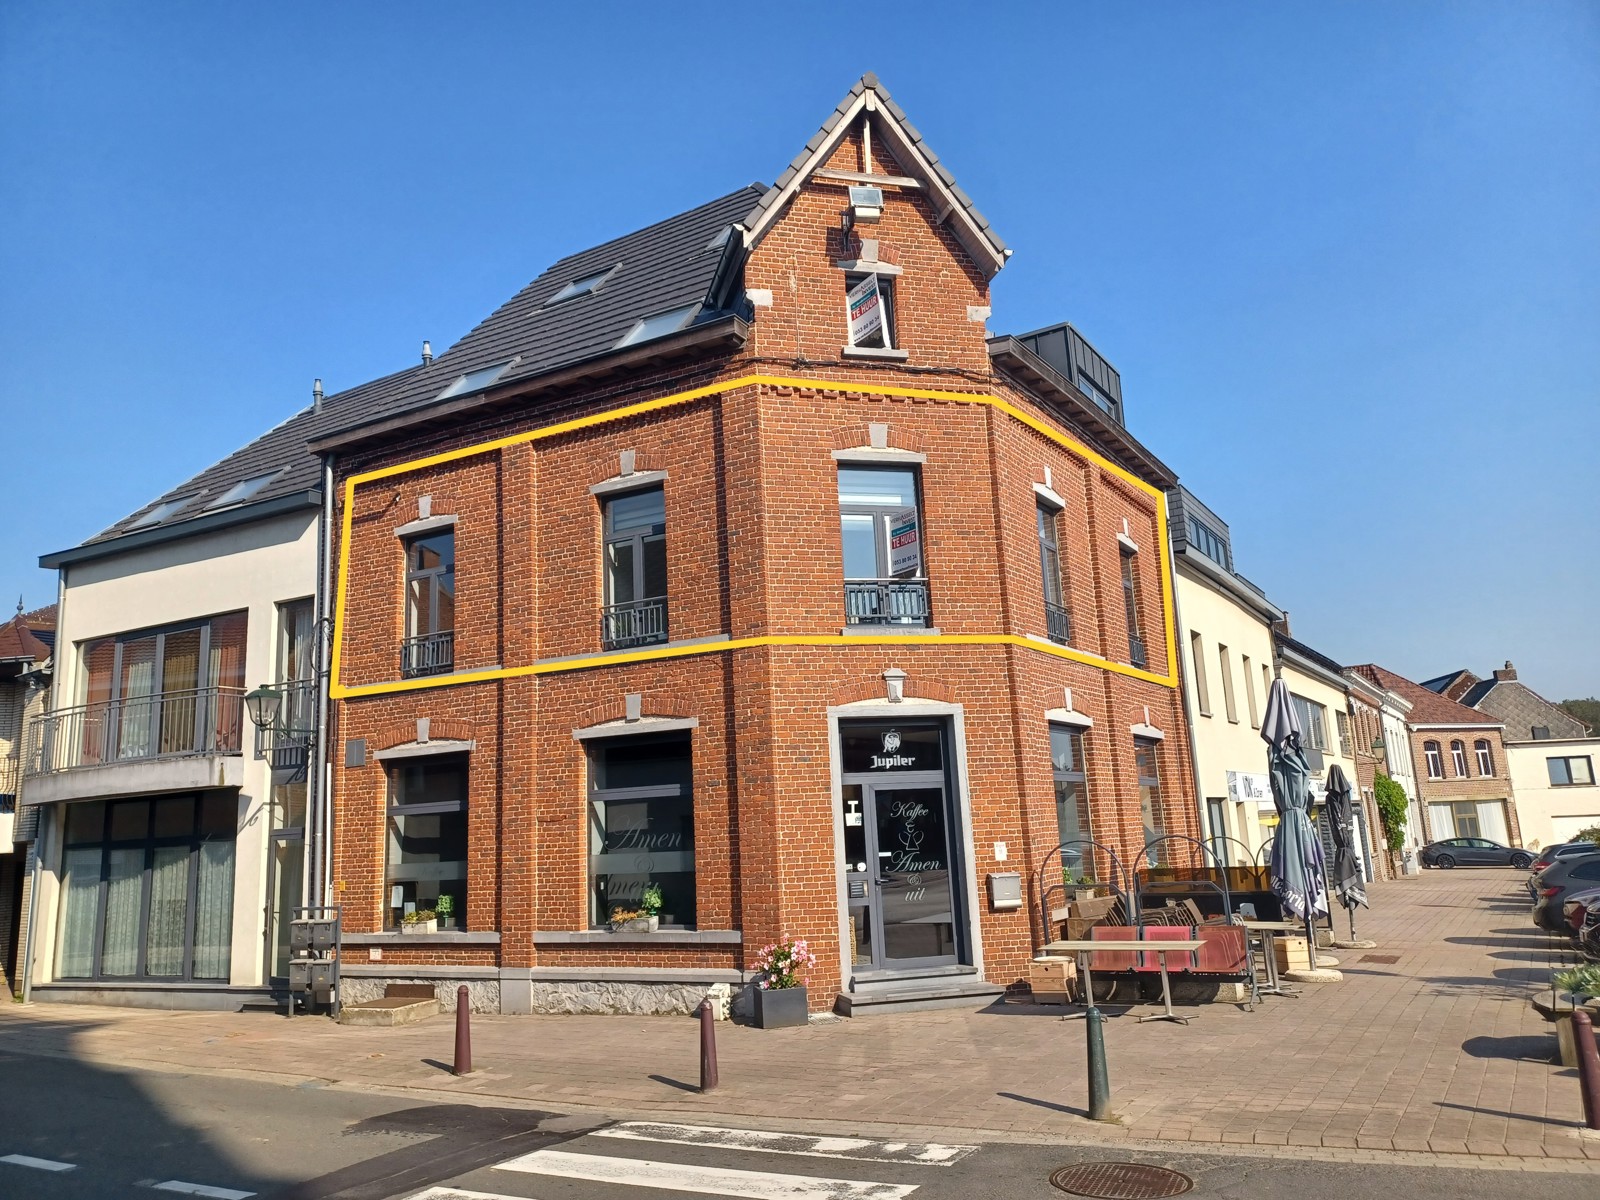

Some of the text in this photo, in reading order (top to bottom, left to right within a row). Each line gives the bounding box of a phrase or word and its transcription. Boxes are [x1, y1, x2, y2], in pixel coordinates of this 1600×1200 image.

[852, 309, 861, 319] TE
[861, 296, 877, 314] HUUR
[893, 532, 916, 547] TE HUUR
[870, 755, 916, 770] Jupiler
[890, 801, 929, 820] Kaffee
[604, 814, 682, 850] Amen
[885, 850, 941, 873] Amen
[905, 887, 926, 902] uit
